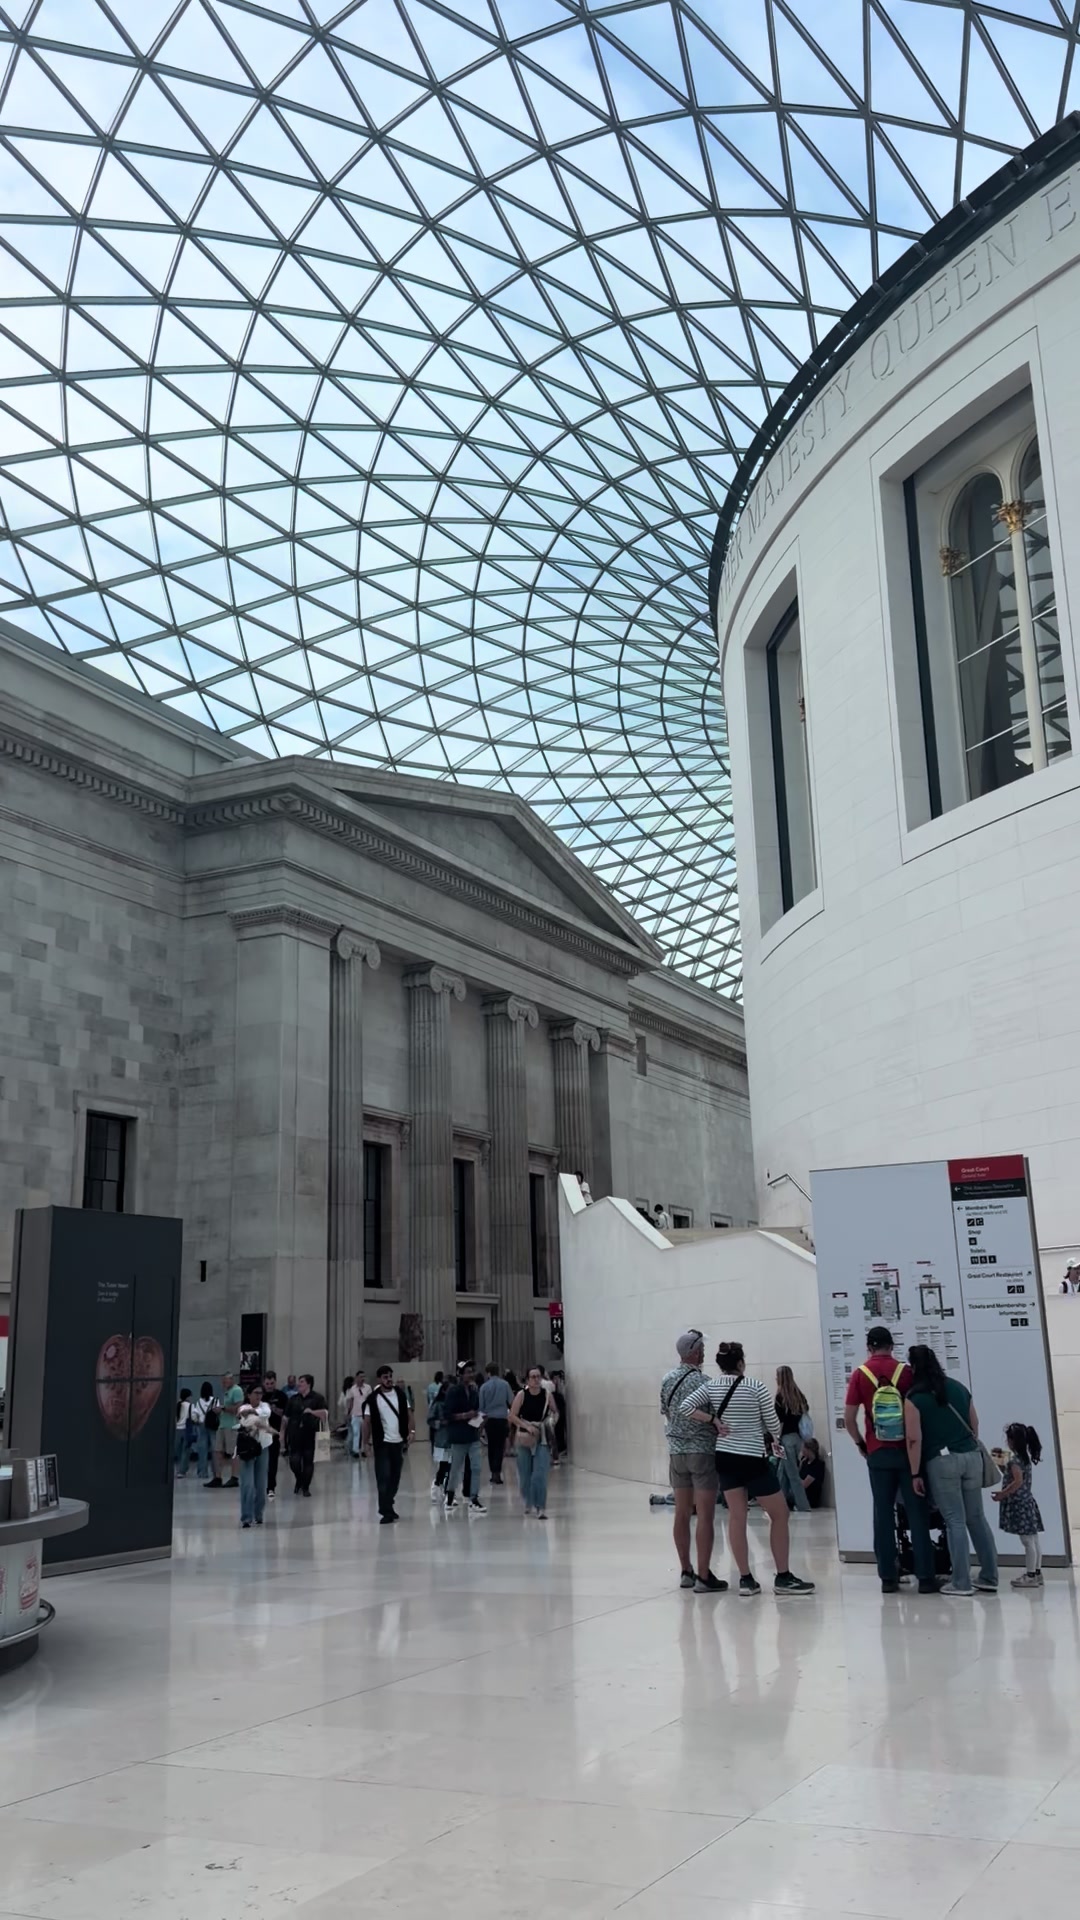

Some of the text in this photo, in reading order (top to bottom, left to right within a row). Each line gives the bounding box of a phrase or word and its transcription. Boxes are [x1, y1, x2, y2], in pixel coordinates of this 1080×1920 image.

[746, 360, 856, 544] MAJESTY
[870, 214, 1019, 381] QUEEN
[1040, 167, 1080, 242] E
